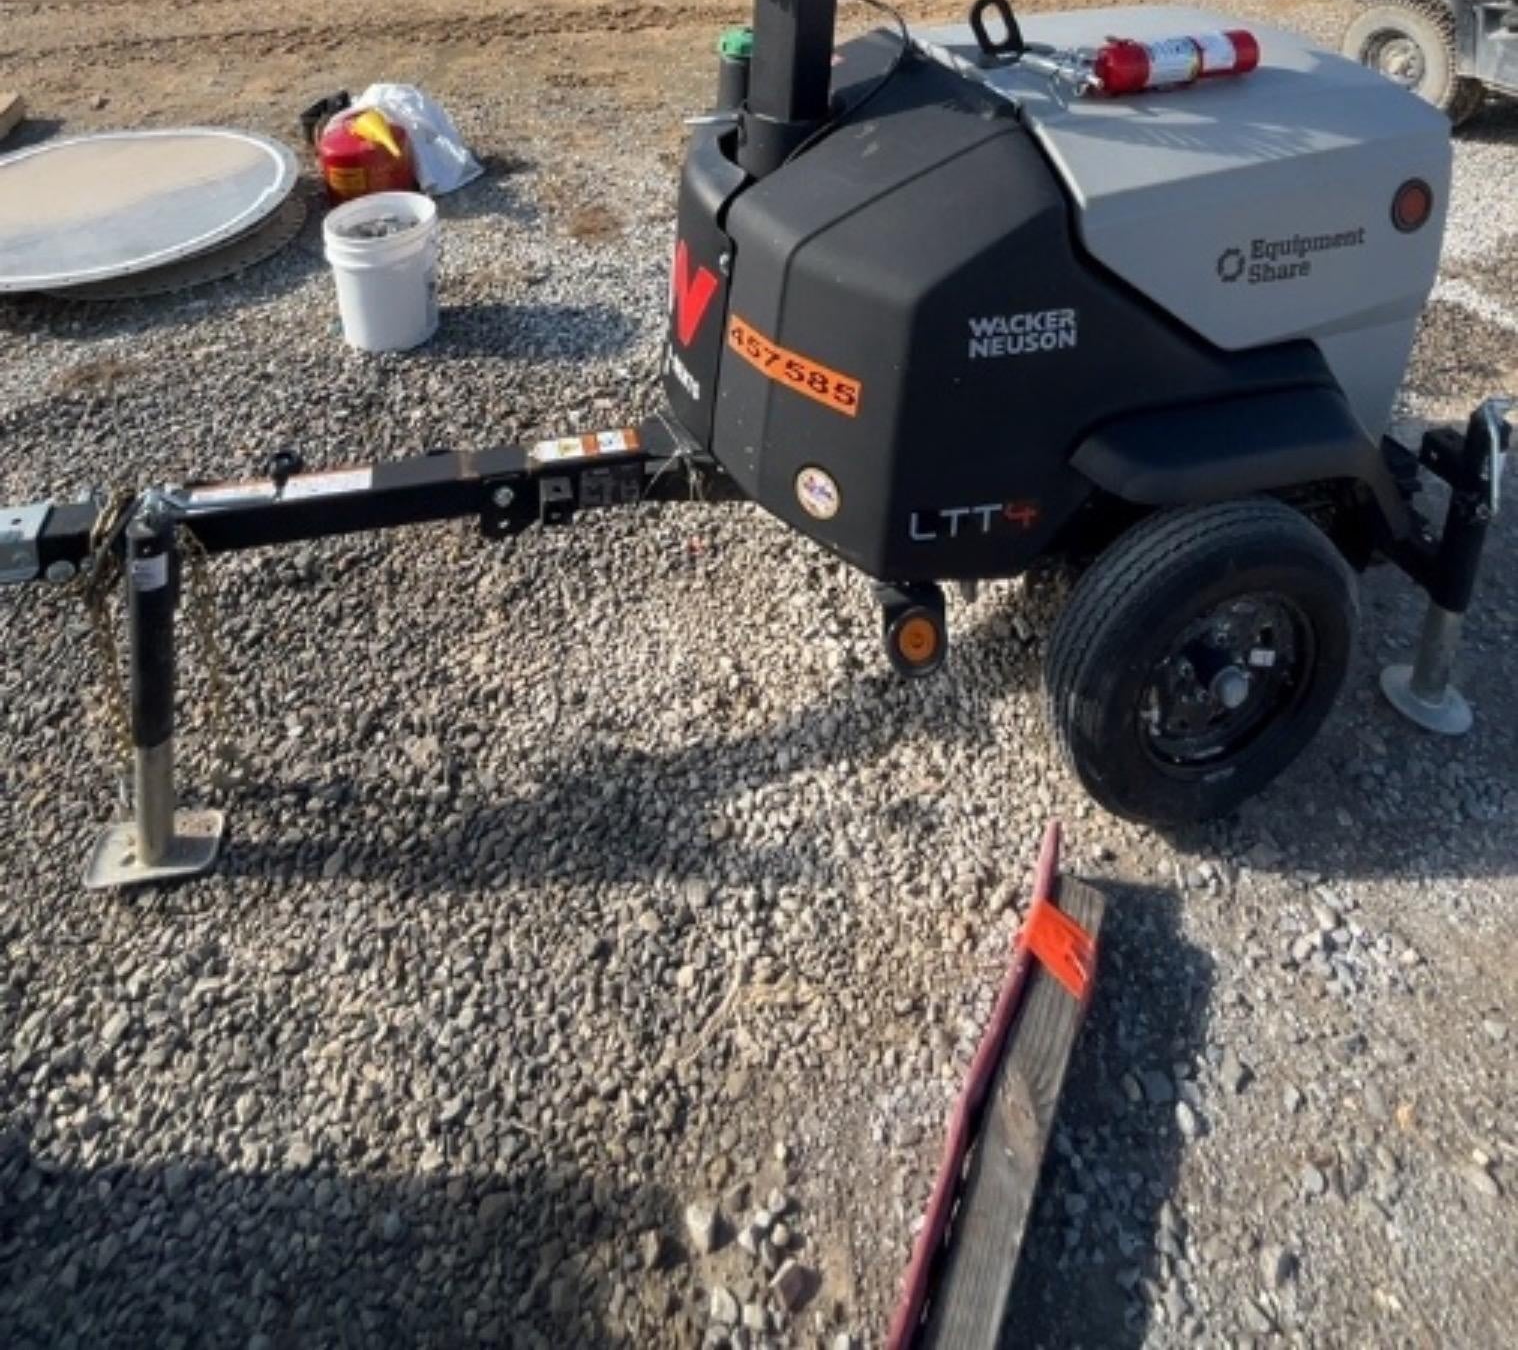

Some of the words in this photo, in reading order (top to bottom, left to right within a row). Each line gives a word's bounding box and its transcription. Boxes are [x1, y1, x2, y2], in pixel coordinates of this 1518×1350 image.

[1251, 226, 1366, 261] Equipment
[1248, 260, 1311, 285] Share
[968, 308, 1076, 337] WACKER
[968, 329, 1077, 358] NEUSON
[732, 326, 856, 406] 457585
[909, 502, 1037, 541] LTT4
